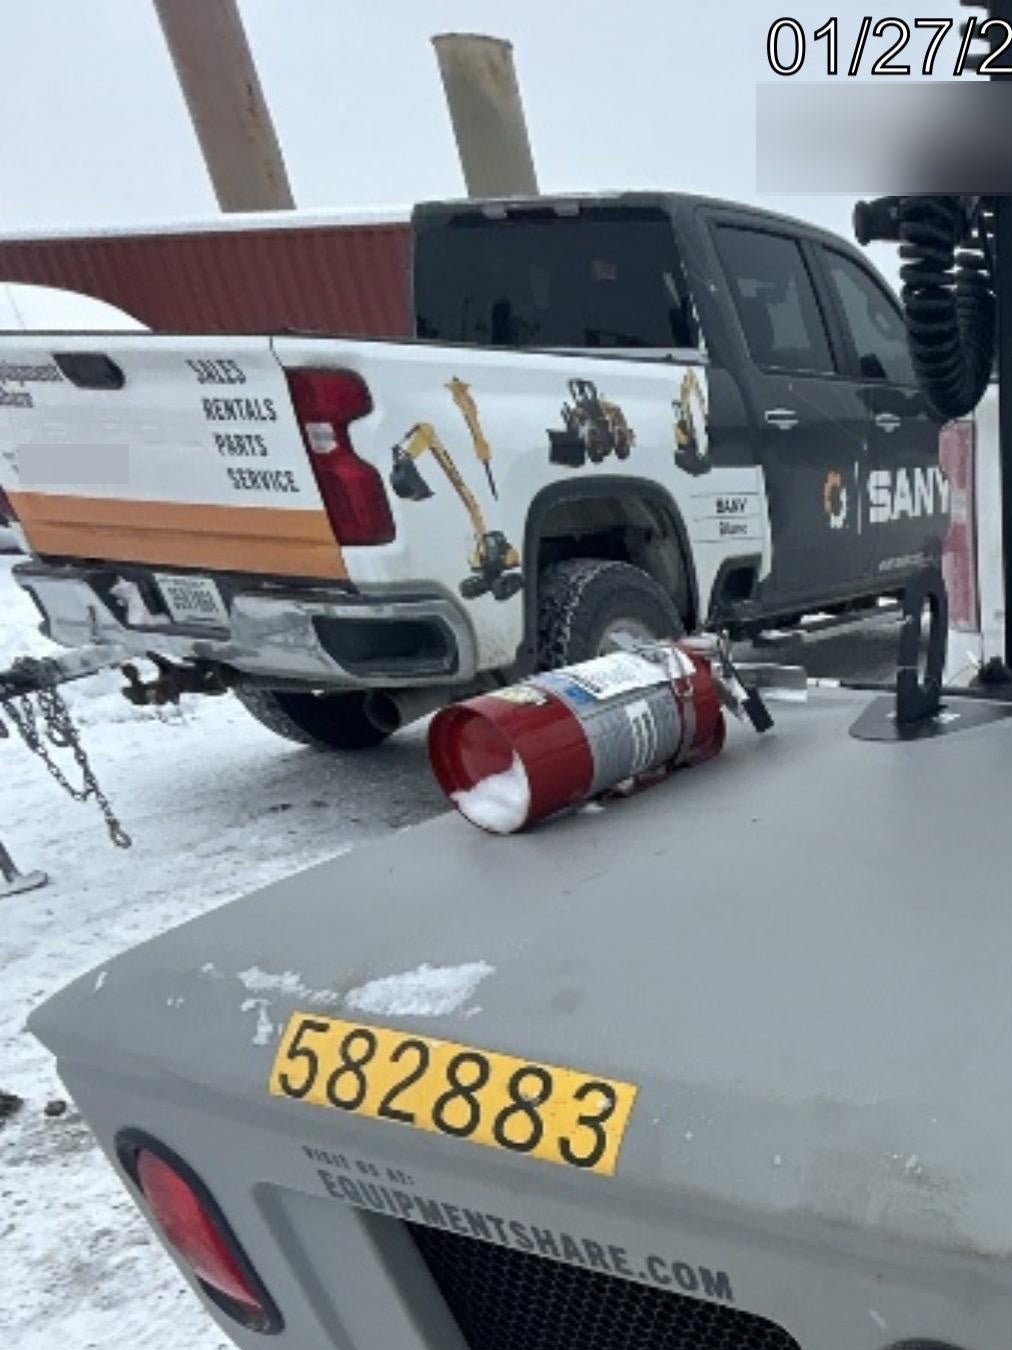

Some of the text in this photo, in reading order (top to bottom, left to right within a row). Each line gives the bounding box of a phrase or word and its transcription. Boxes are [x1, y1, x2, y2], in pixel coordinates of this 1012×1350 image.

[185, 359, 246, 384] SALES
[201, 398, 277, 422] RENTALS
[213, 433, 268, 456] PARTS
[226, 467, 301, 492] SERVICE
[866, 467, 950, 523] SANY
[278, 1019, 617, 1168] 582883
[317, 1169, 735, 1302] EQUIPMENTSHARE.COM
